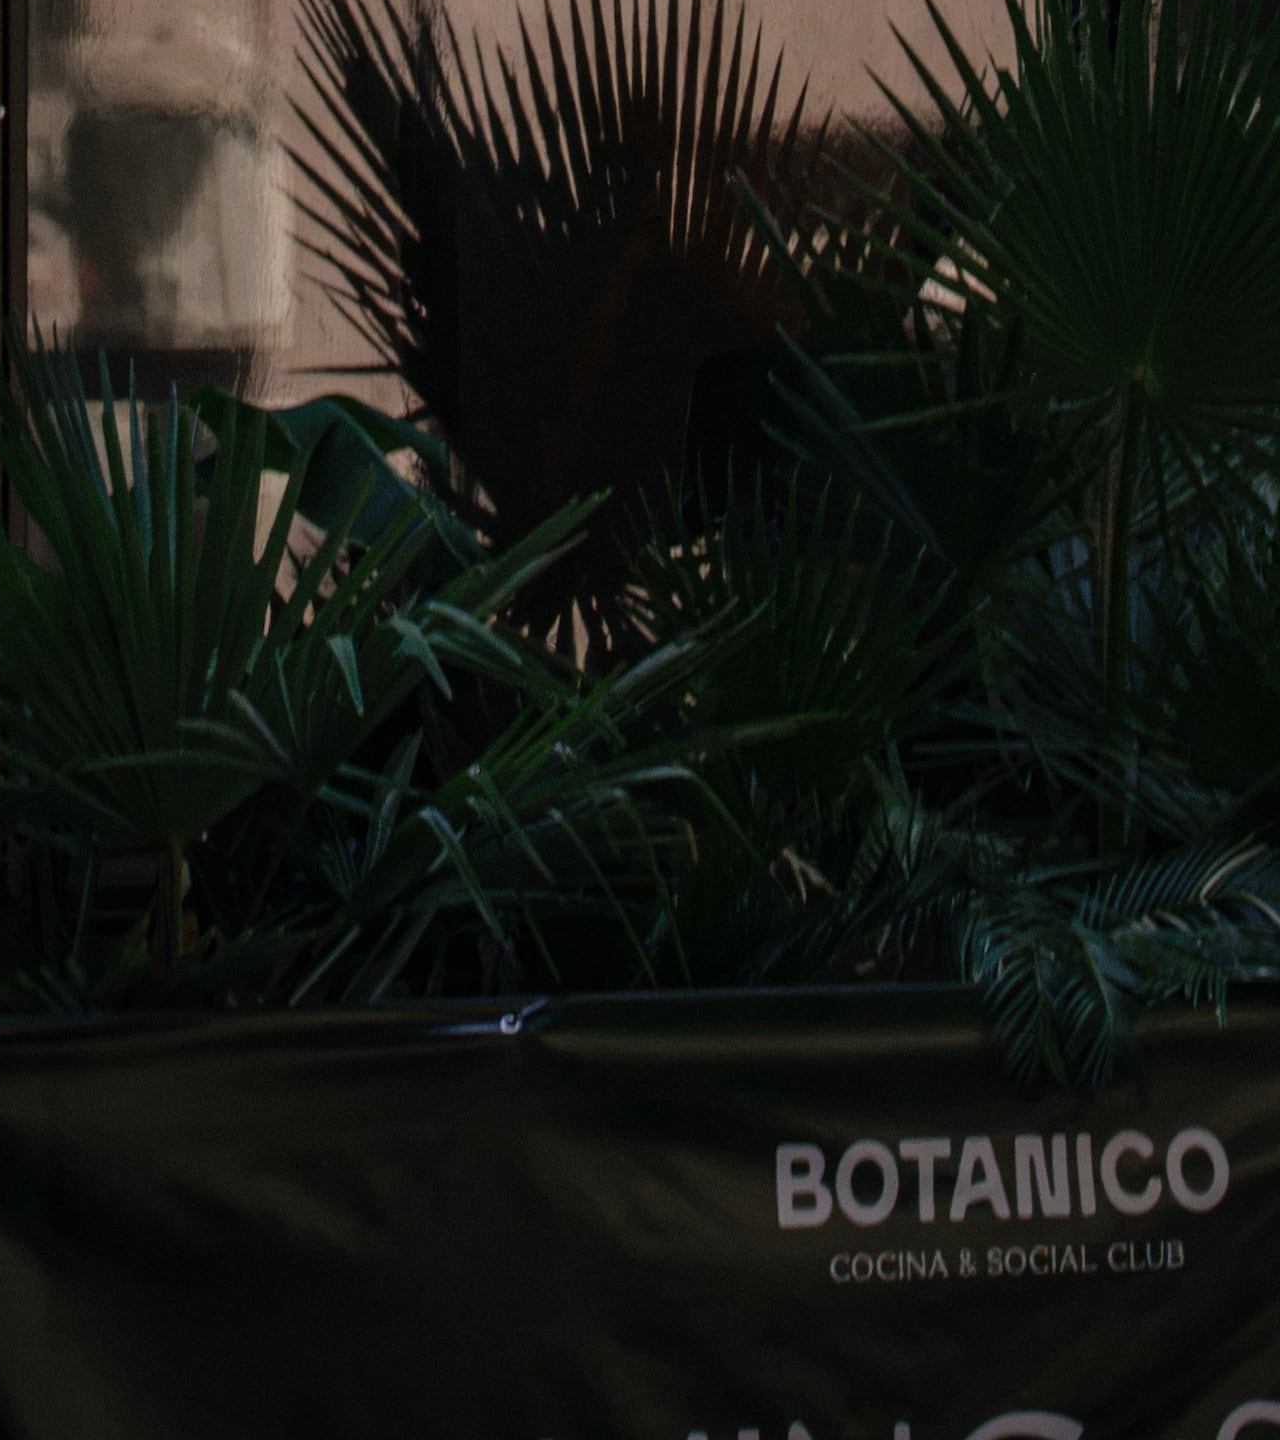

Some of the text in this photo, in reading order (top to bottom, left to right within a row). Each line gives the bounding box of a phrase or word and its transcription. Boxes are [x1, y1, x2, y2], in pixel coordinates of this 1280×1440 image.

[776, 1126, 1229, 1229] BOTANICO
[829, 1239, 1184, 1284] COCINA & SOCIAL CLUB
